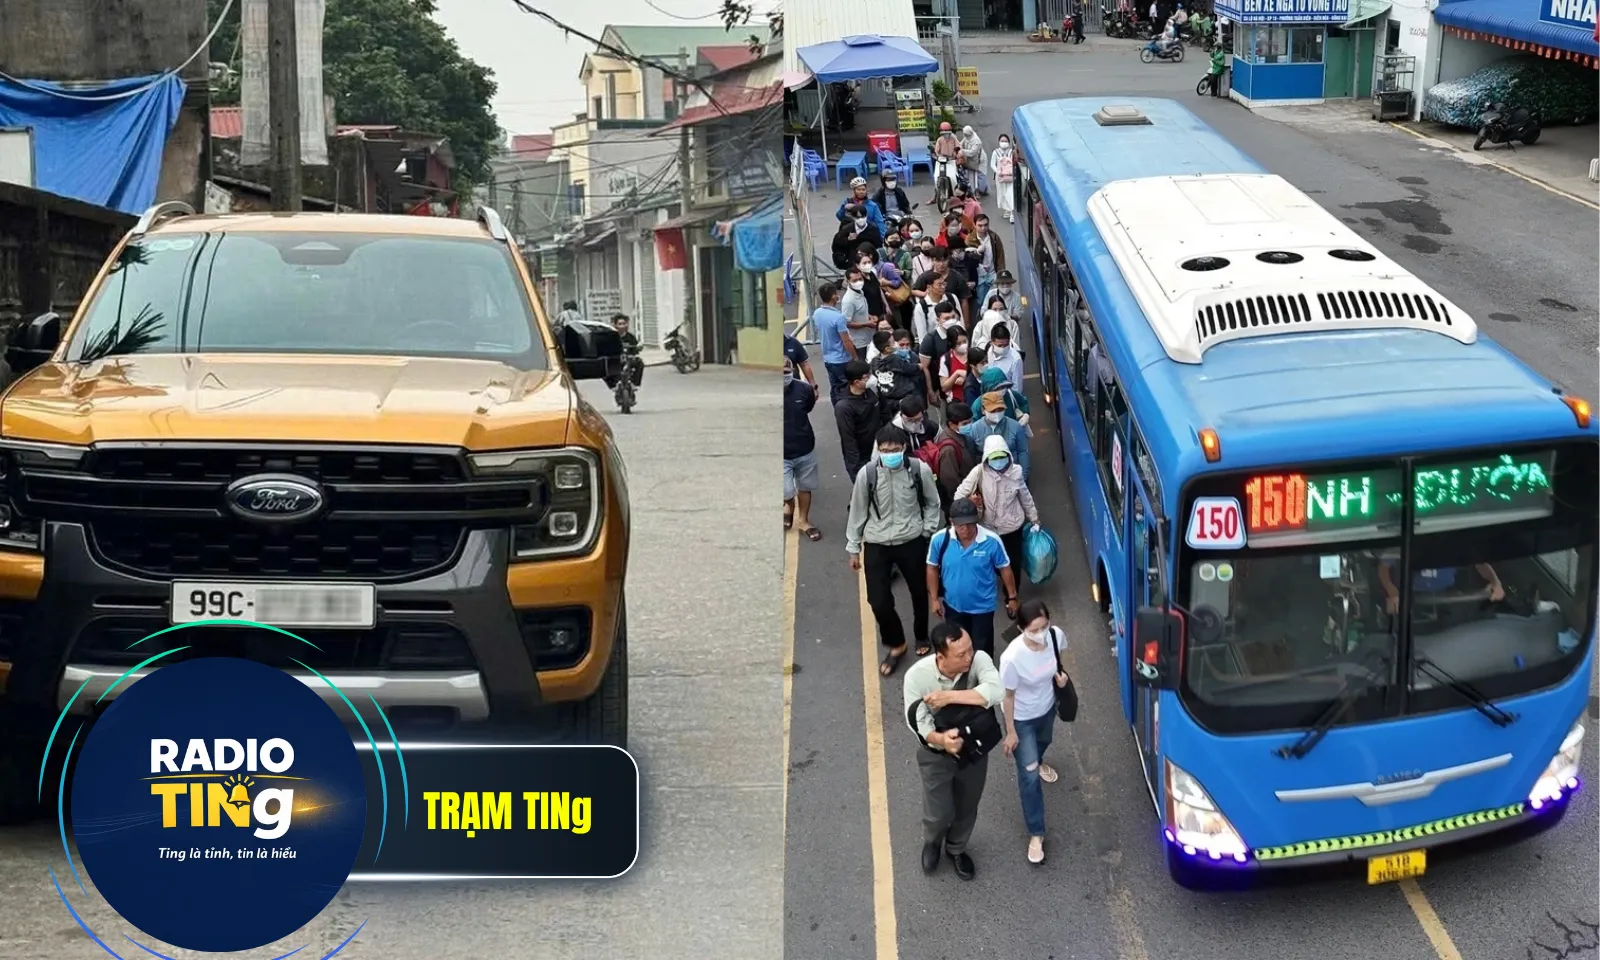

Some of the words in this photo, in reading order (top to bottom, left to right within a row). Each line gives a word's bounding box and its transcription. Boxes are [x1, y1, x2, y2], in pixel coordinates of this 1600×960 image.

[251, 489, 300, 510] Ford
[1246, 474, 1305, 528] 150
[1196, 506, 1238, 540] 150
